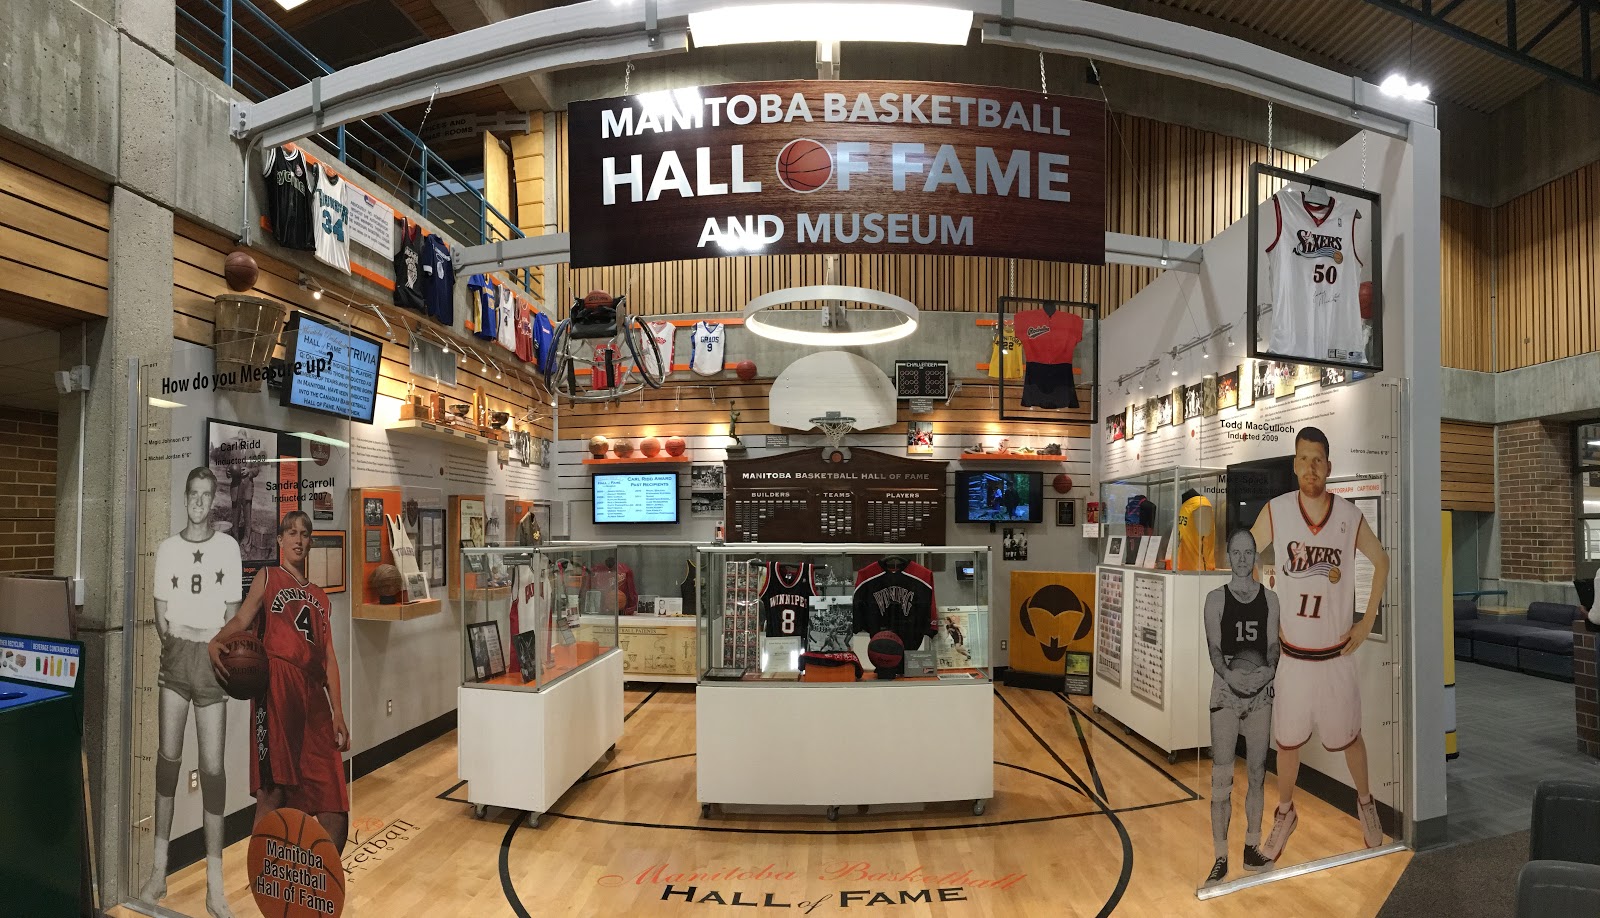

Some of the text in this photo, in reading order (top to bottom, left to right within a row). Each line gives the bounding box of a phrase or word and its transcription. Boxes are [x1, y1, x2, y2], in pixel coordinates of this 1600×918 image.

[601, 92, 1071, 139] MANITOBA BASKETBALL
[444, 127, 473, 136] ROOMS
[602, 144, 762, 206] HALL
[892, 142, 1071, 203] FAME
[322, 209, 345, 243] 34
[696, 213, 974, 250] AND MUSEUM
[1313, 264, 1337, 285] 50
[303, 335, 320, 348] HALL
[326, 342, 342, 355] FAME
[707, 343, 713, 352] 9
[1003, 341, 1014, 350] 22
[347, 346, 376, 366] TRIVIA
[162, 376, 190, 395] How
[192, 371, 209, 390] do
[213, 373, 236, 392] you
[240, 360, 302, 383] Measure
[306, 351, 334, 377] up?
[310, 390, 319, 398] THE
[1220, 420, 1295, 433] Todd MacCulloch
[220, 439, 261, 452] Carl Ridd
[1227, 432, 1278, 442] Inducted 2009
[215, 456, 246, 466] Inducted
[265, 477, 335, 491] Sandra Carroll
[795, 472, 858, 480] BASKETBALL
[861, 472, 887, 480] HALL
[1218, 474, 1269, 486] Mike Spack
[271, 491, 328, 503] Inducted 2007
[1357, 484, 1380, 492] CAPTIONS
[190, 573, 202, 595] 8
[1296, 594, 1322, 619] 11
[293, 604, 316, 646] 4
[781, 609, 795, 634] 8
[1235, 620, 1258, 642] 15
[7, 640, 24, 648] RECYCLING
[33, 643, 49, 651] BEVERAGE
[49, 645, 70, 654] CONTAINERS
[266, 839, 324, 871] Manitoba
[264, 858, 327, 892] Basketball
[596, 860, 1029, 892] Manitoba Basketball
[257, 876, 335, 915] Hall of Fame
[660, 884, 968, 915] HALL of FAME
